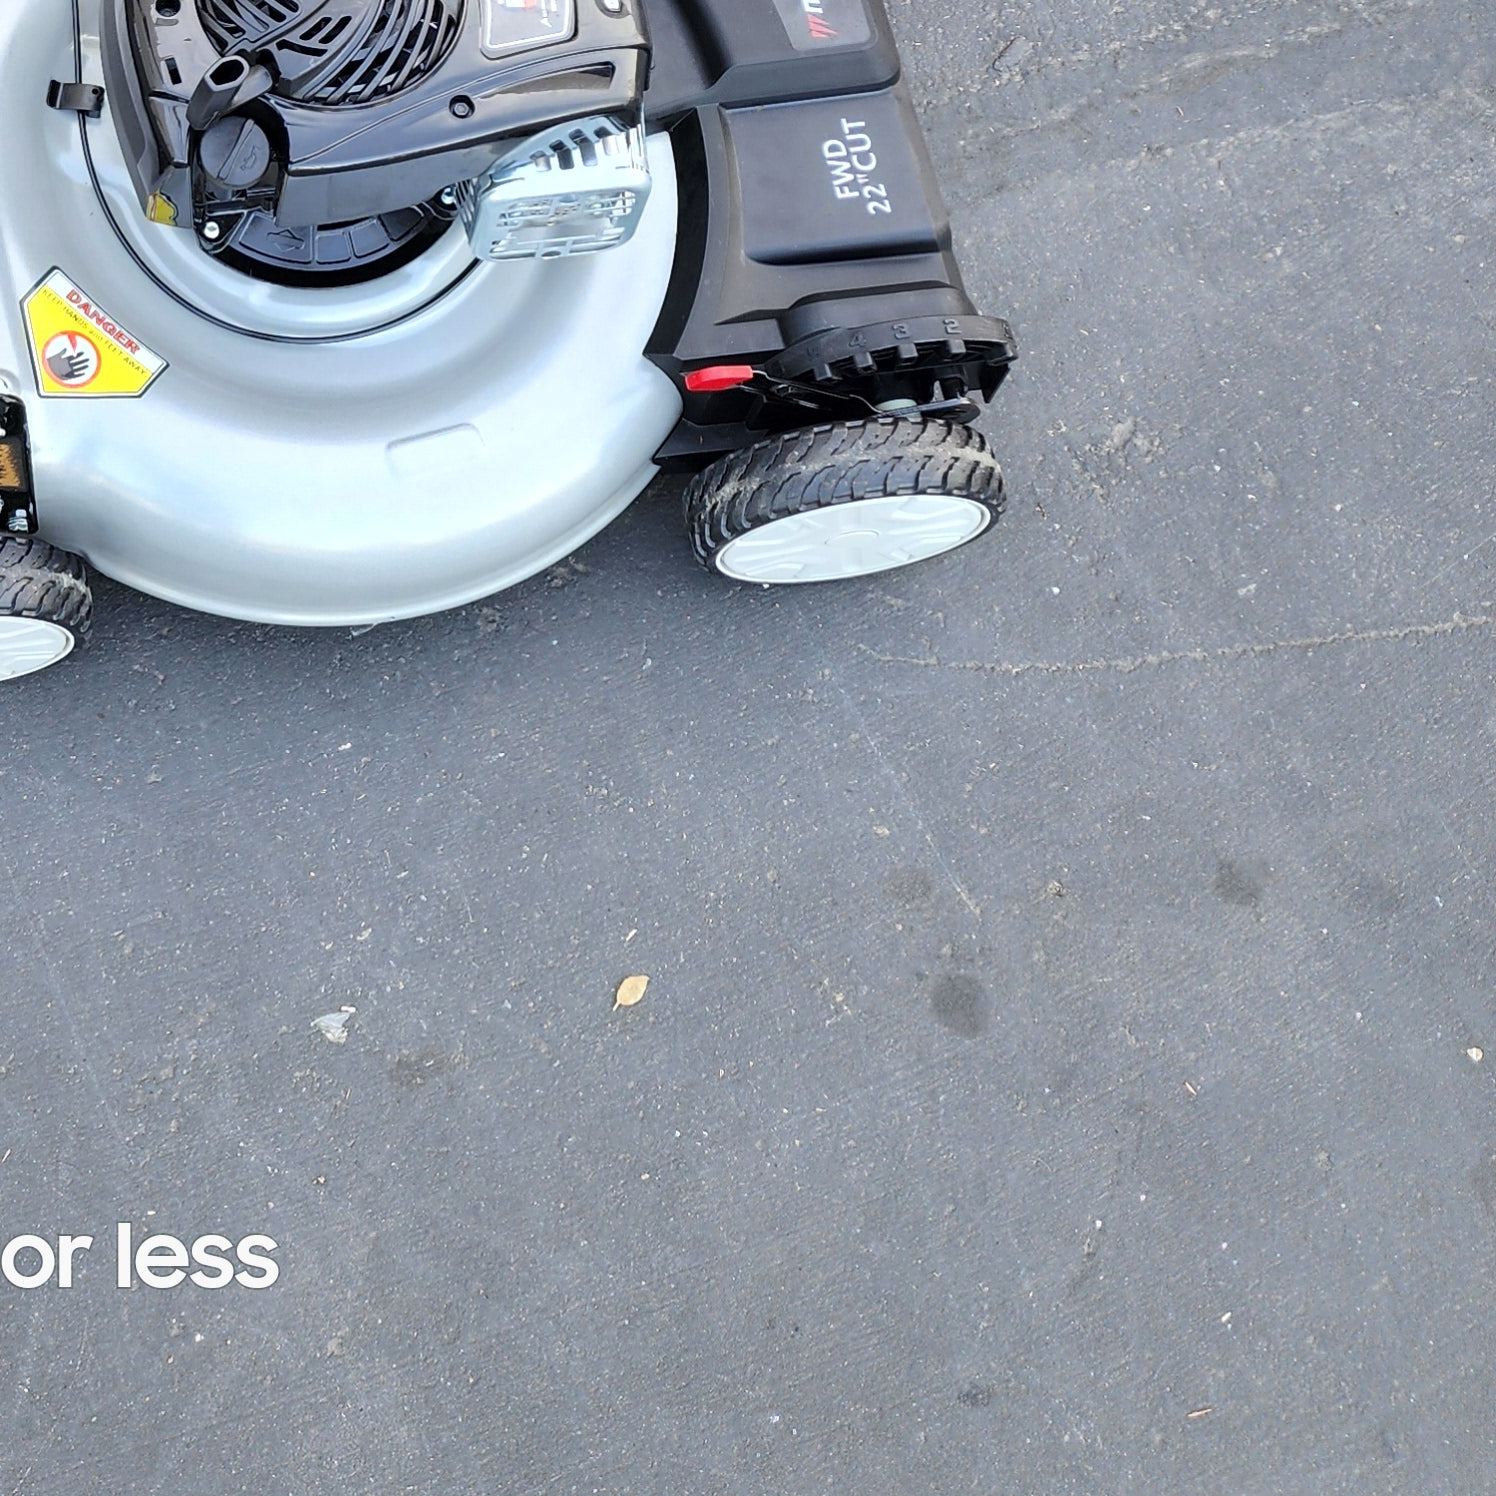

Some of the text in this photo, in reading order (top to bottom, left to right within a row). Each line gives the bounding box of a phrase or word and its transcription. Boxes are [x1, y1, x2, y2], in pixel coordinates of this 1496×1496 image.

[822, 139, 860, 199] FWD
[63, 306, 88, 329] HANDS
[104, 340, 123, 356] FEET
[123, 356, 146, 375] AWAY
[65, 288, 140, 355] DANGER
[892, 323, 909, 340] 3
[943, 318, 961, 335] 2
[848, 334, 866, 348] 4
